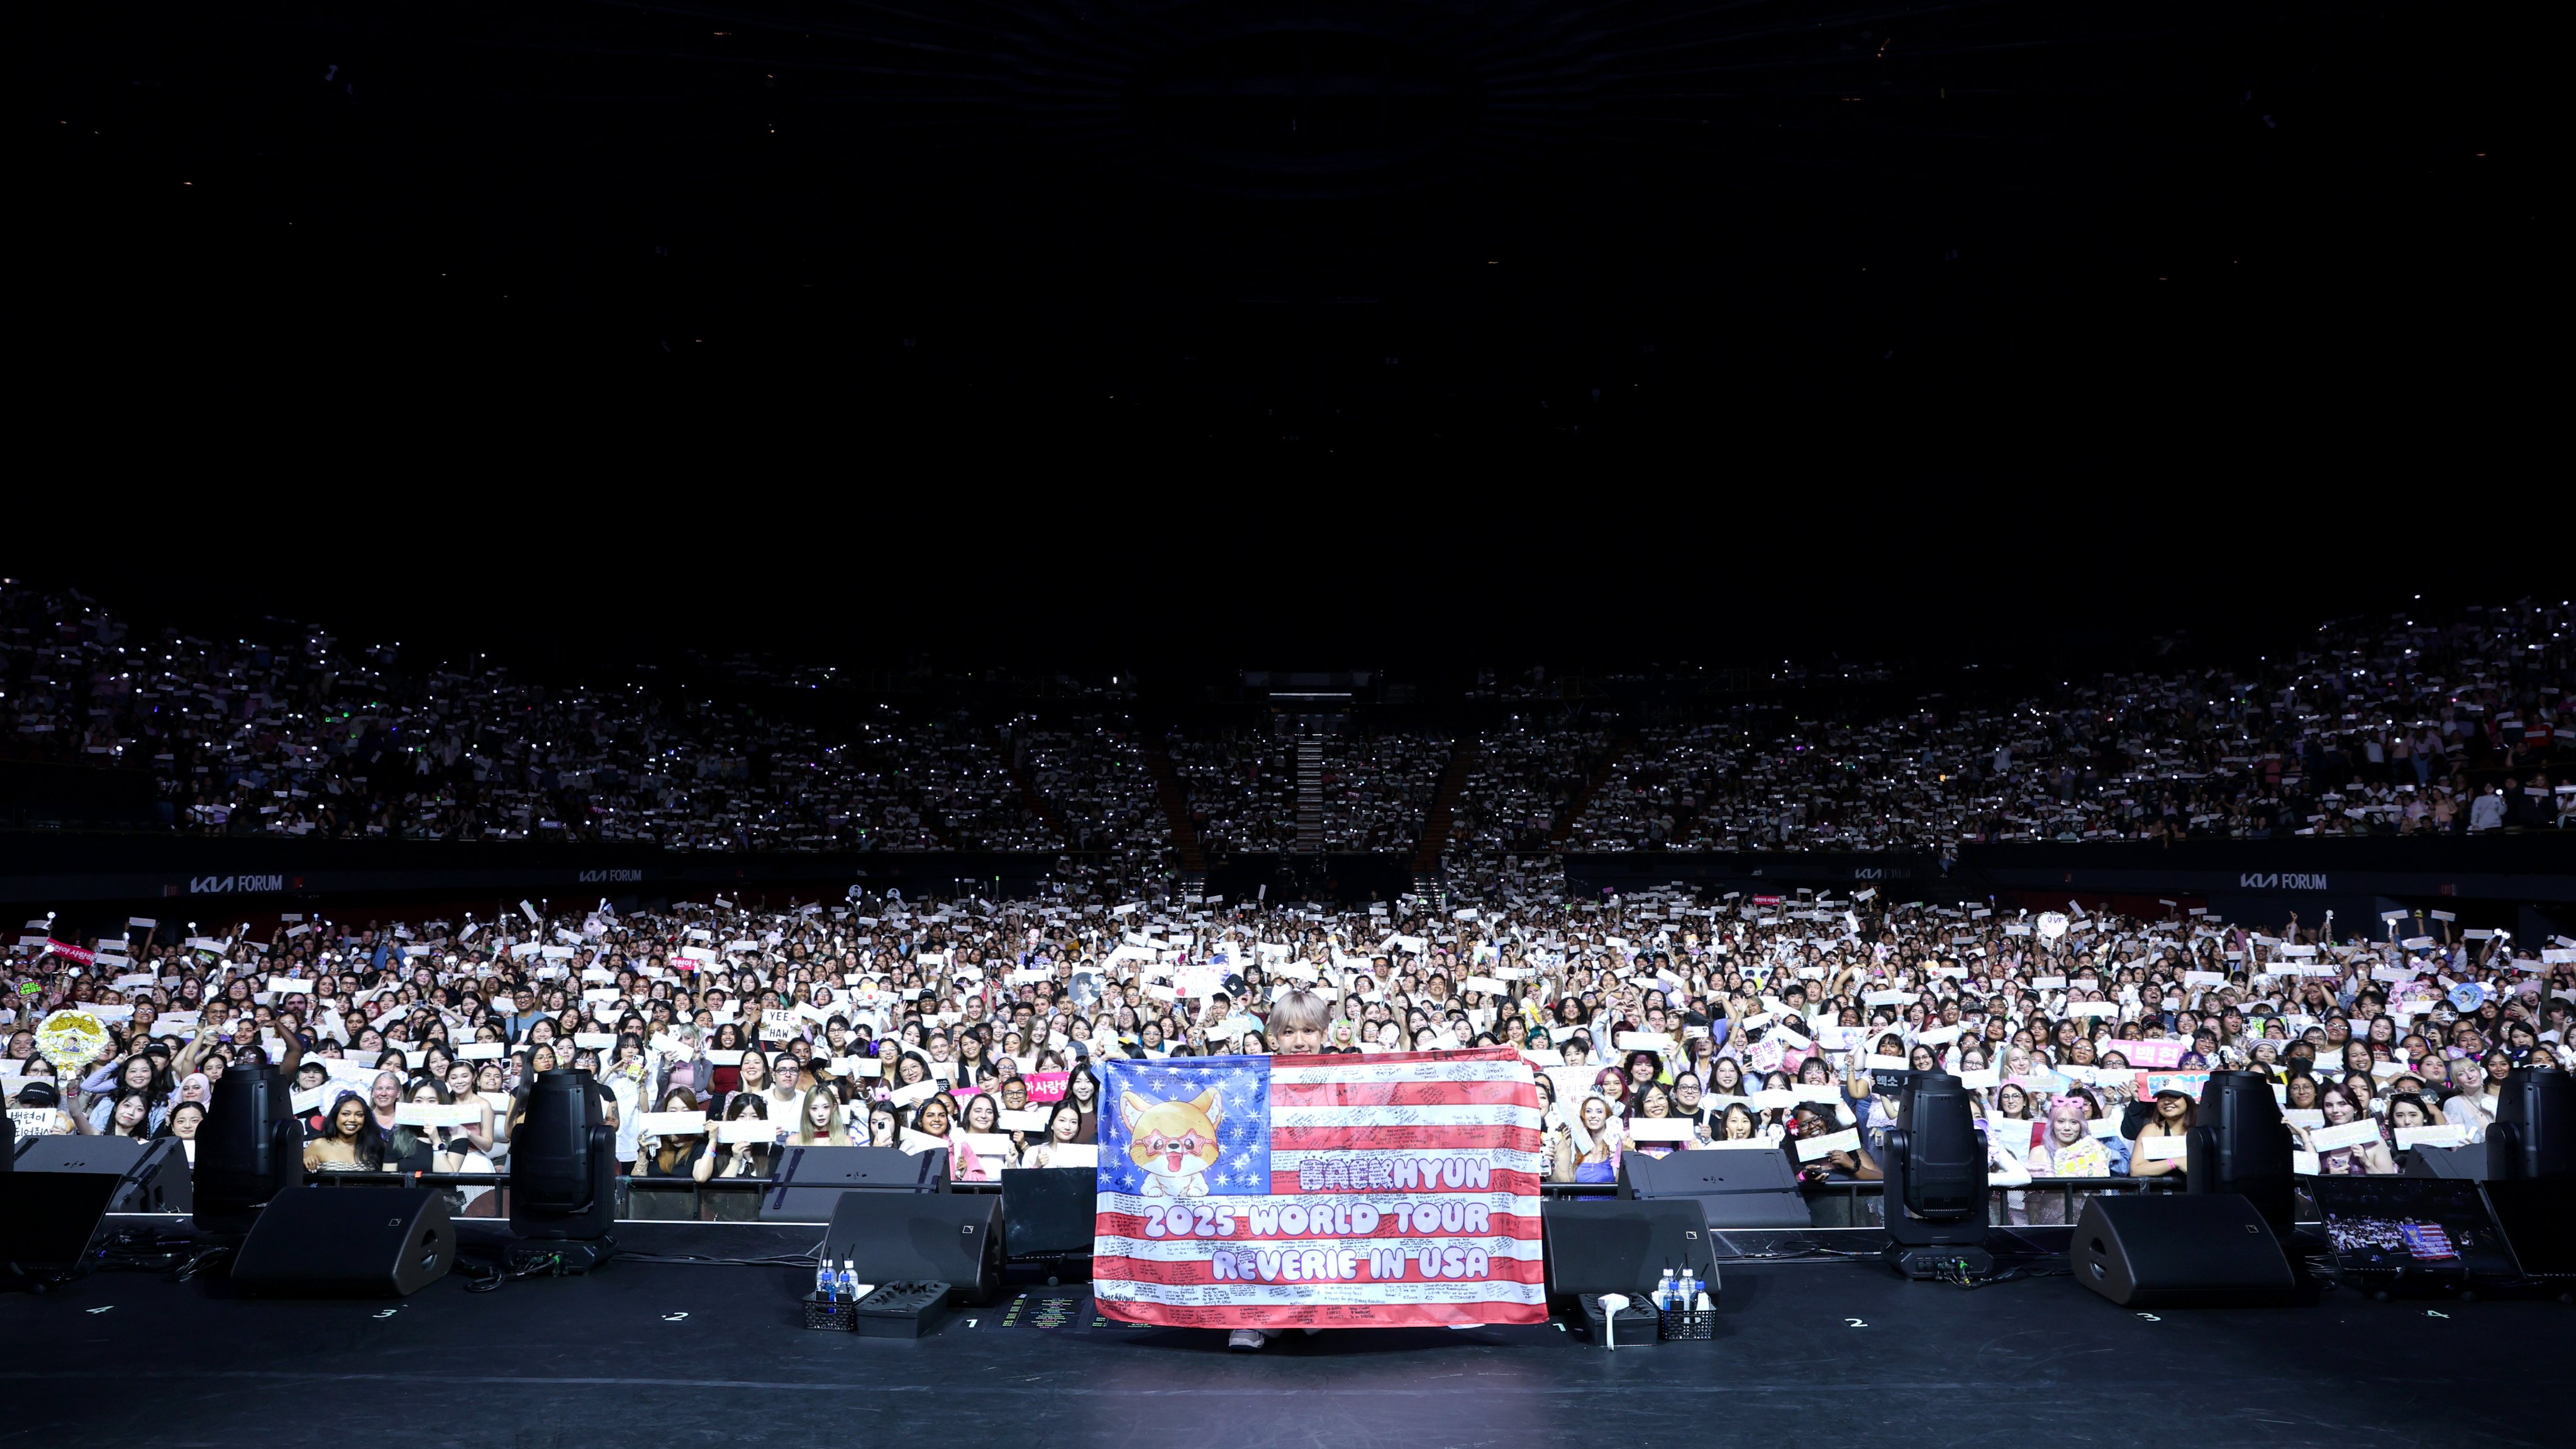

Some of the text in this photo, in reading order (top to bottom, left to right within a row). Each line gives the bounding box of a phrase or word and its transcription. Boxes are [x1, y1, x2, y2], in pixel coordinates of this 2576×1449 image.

[579, 869, 642, 882] KIA FORUM
[1855, 867, 1882, 880] KIA
[191, 875, 234, 893] KIA
[238, 875, 282, 892] FORUM
[2240, 873, 2327, 890] KIA FORUM
[770, 1011, 789, 1021] YEE
[769, 1030, 789, 1038] HAW
[1876, 1075, 1898, 1087] 엑소
[11, 1111, 46, 1125] 백현이
[1299, 1157, 1491, 1191] BAEKHYUN
[1143, 1205, 1236, 1238] 2025
[1248, 1202, 1380, 1236] WORLD
[1392, 1202, 1490, 1234] TOUR
[1212, 1248, 1358, 1282] REVERIE
[1369, 1248, 1406, 1280] IN
[1418, 1246, 1489, 1279] USA
[85, 1305, 114, 1314] 4
[372, 1309, 397, 1318] 3
[2427, 1310, 2450, 1319] 4
[664, 1312, 689, 1321] 2
[2136, 1313, 2162, 1321] 3
[966, 1319, 978, 1328] 1
[1552, 1323, 1567, 1331] 1
[1845, 1318, 1868, 1327] 2
